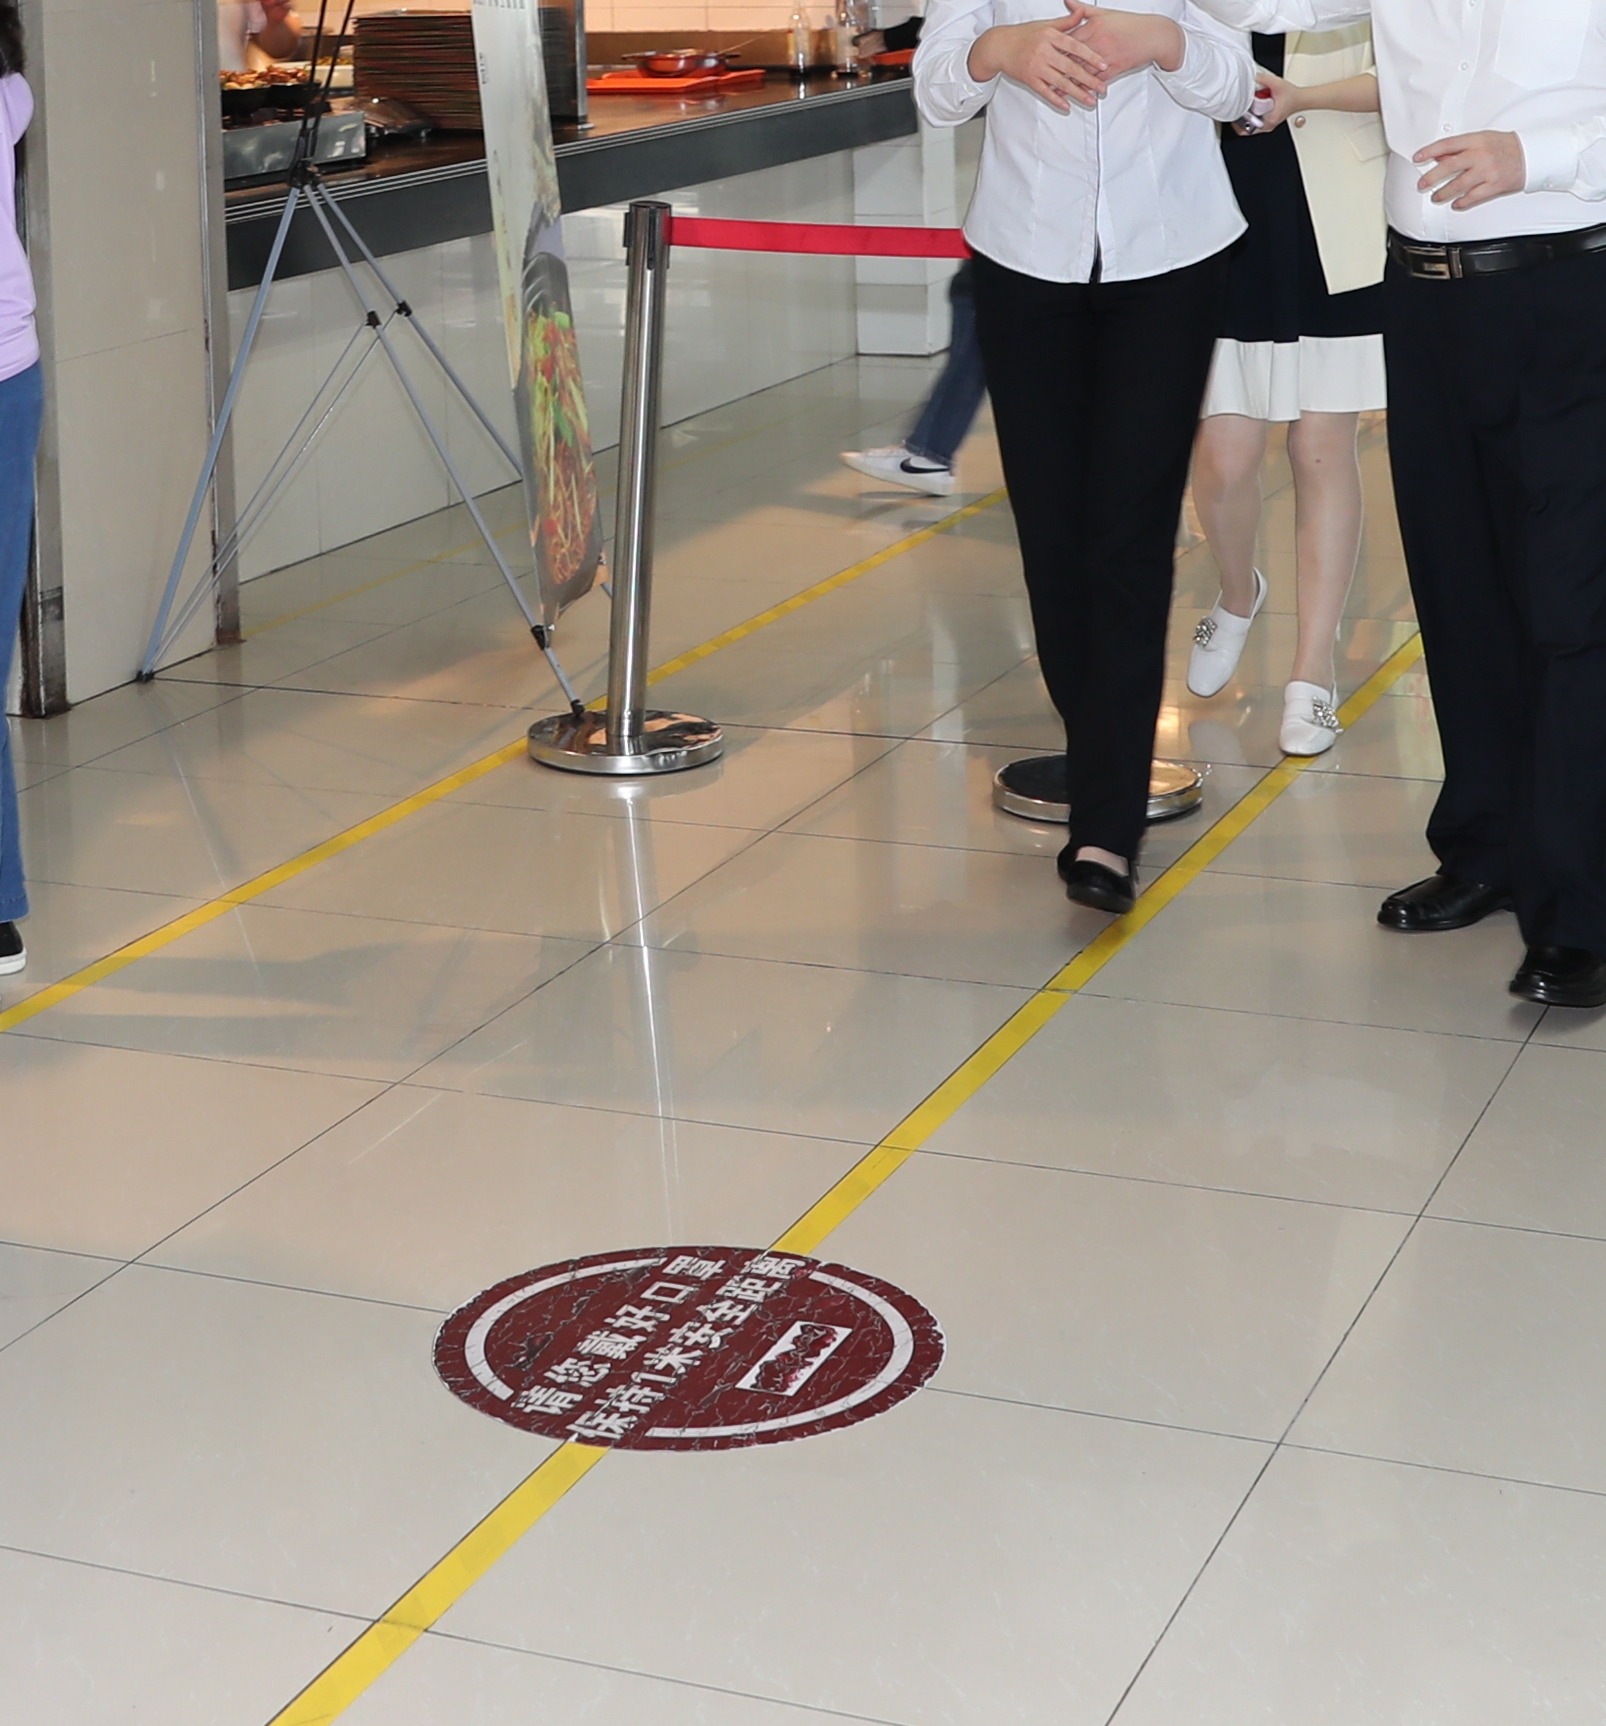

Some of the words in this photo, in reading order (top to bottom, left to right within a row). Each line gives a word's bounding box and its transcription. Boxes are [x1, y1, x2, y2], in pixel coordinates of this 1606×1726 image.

[509, 1254, 727, 1415] 请您戴好口罩
[565, 1255, 806, 1440] 保持1米安全距离
